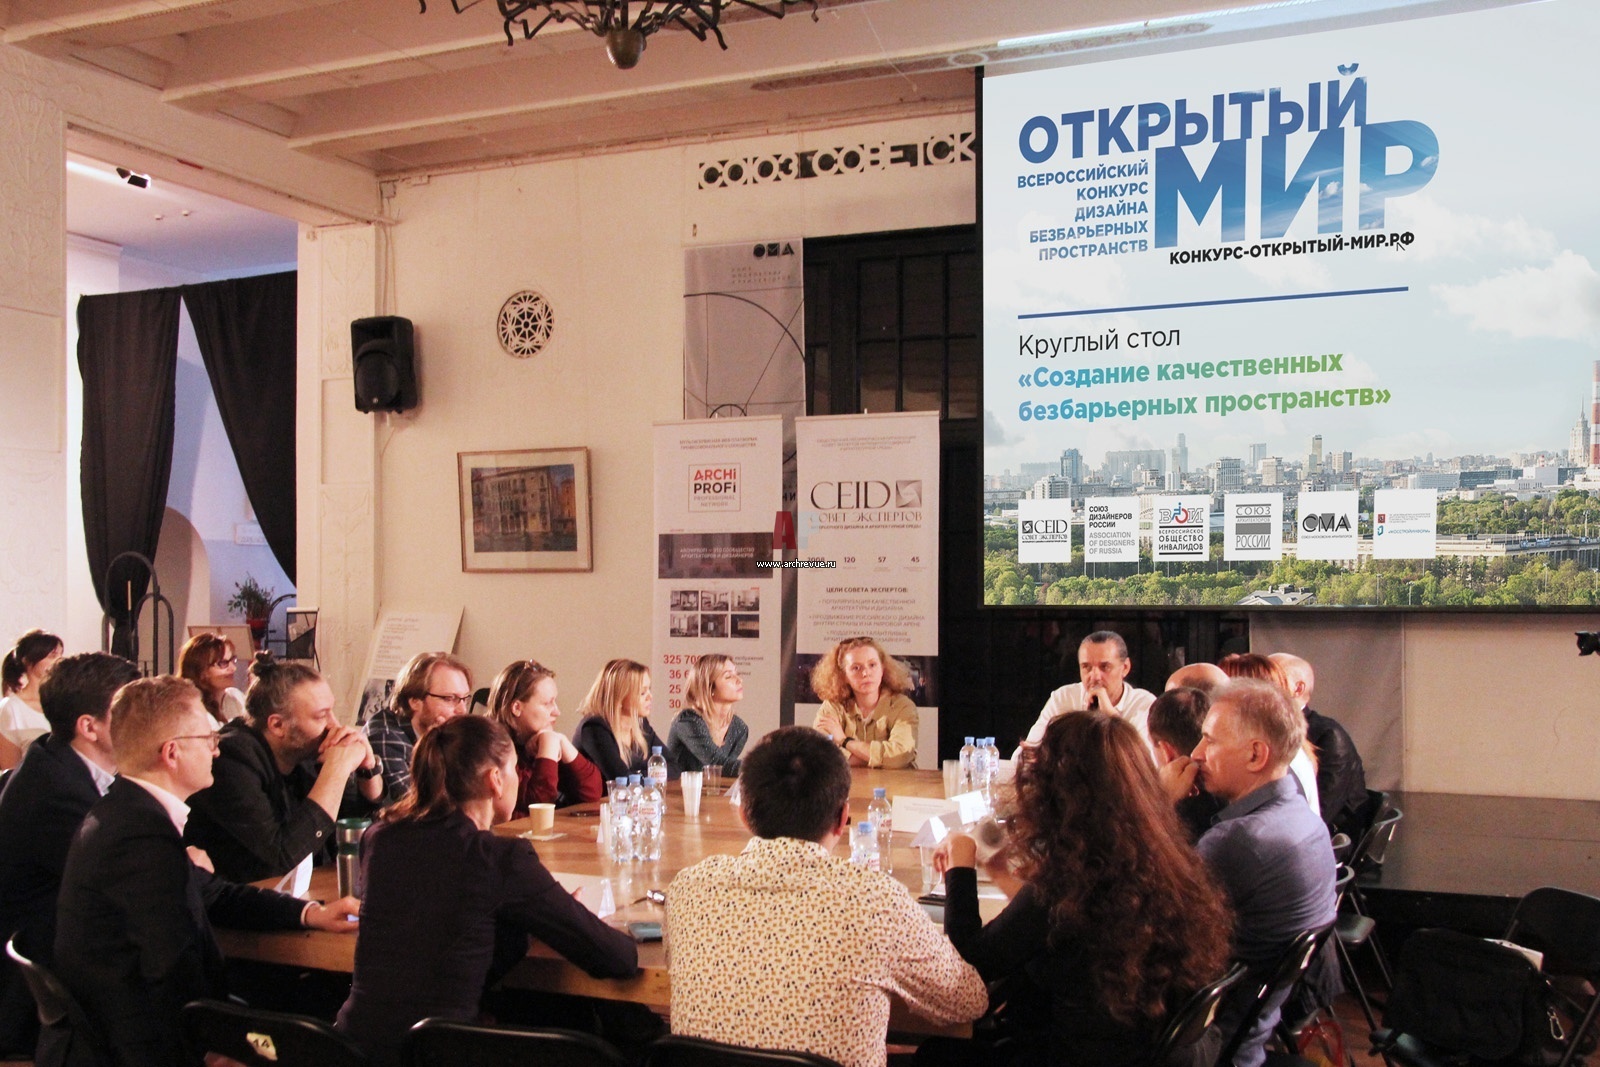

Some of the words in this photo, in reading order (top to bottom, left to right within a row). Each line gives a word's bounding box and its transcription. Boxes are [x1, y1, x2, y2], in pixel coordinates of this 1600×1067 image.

[1018, 62, 1368, 164] ОТКРЫТЫЙ
[698, 150, 800, 190] СОЮЗ
[1016, 158, 1149, 189] ВСЕРОССИЙСКИЙ
[1154, 118, 1440, 249] МИР
[1076, 181, 1149, 202] КОНКУРС
[1074, 200, 1149, 223] ДИЗАЙНА
[1029, 219, 1149, 244] БЕЗБАРЬЕРНЫХ
[1038, 238, 1149, 262] ПРОСТРАНСТВ
[1169, 230, 1416, 265] КОНКУРС-ОТКРЫТЫЙ-МИР.РФ
[1018, 328, 1119, 359] Круглый
[1126, 328, 1181, 349] стол
[1018, 361, 1150, 389] «Создание
[1157, 353, 1343, 382] качественных
[1018, 392, 1198, 424] безбарьерных
[1205, 387, 1392, 417] пространств»
[810, 480, 891, 510] CEID
[1088, 505, 1109, 513] СОЮЗ
[1236, 506, 1271, 515] СОЮЗ
[852, 511, 922, 522] ЭКСПЕРТОВ
[1088, 513, 1133, 521] ДИЗАЙНЕРОВ
[1034, 519, 1068, 534] CEID
[1088, 521, 1116, 529] РОССИИ
[1088, 531, 1132, 539] ASSOCIATION
[1158, 534, 1204, 543] ОБЩЕСТВО
[1236, 535, 1271, 548] РОССИИ
[1099, 539, 1136, 547] DESIGNERS
[1158, 543, 1204, 551] ИНВАЛИДОВ
[1099, 547, 1123, 555] RUSSIA
[663, 655, 681, 664] 325
[669, 669, 682, 679] 36
[669, 684, 682, 694] 25
[669, 699, 682, 708] 30
